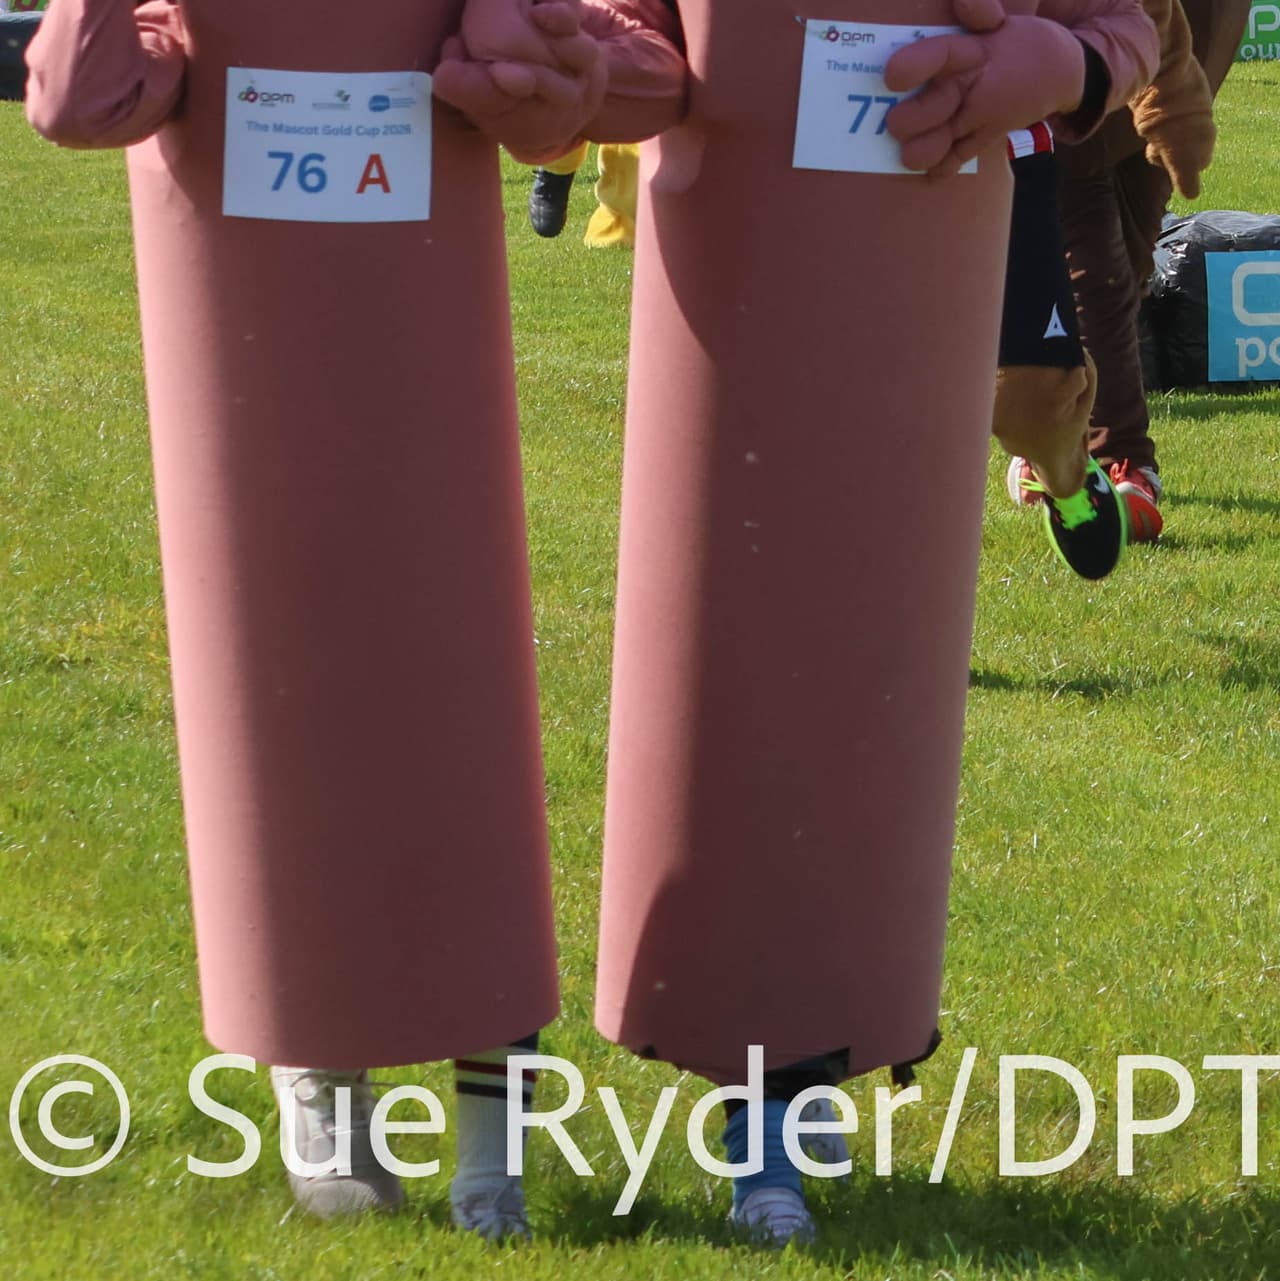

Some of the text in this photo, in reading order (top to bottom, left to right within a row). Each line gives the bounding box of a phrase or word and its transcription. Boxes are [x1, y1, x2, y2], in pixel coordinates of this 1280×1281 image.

[826, 59, 848, 73] The
[247, 120, 269, 133] The
[273, 122, 319, 135] Mascot
[321, 124, 353, 137] Gold
[355, 125, 380, 138] Cup
[848, 94, 897, 135] 77
[267, 151, 391, 194] 76 A
